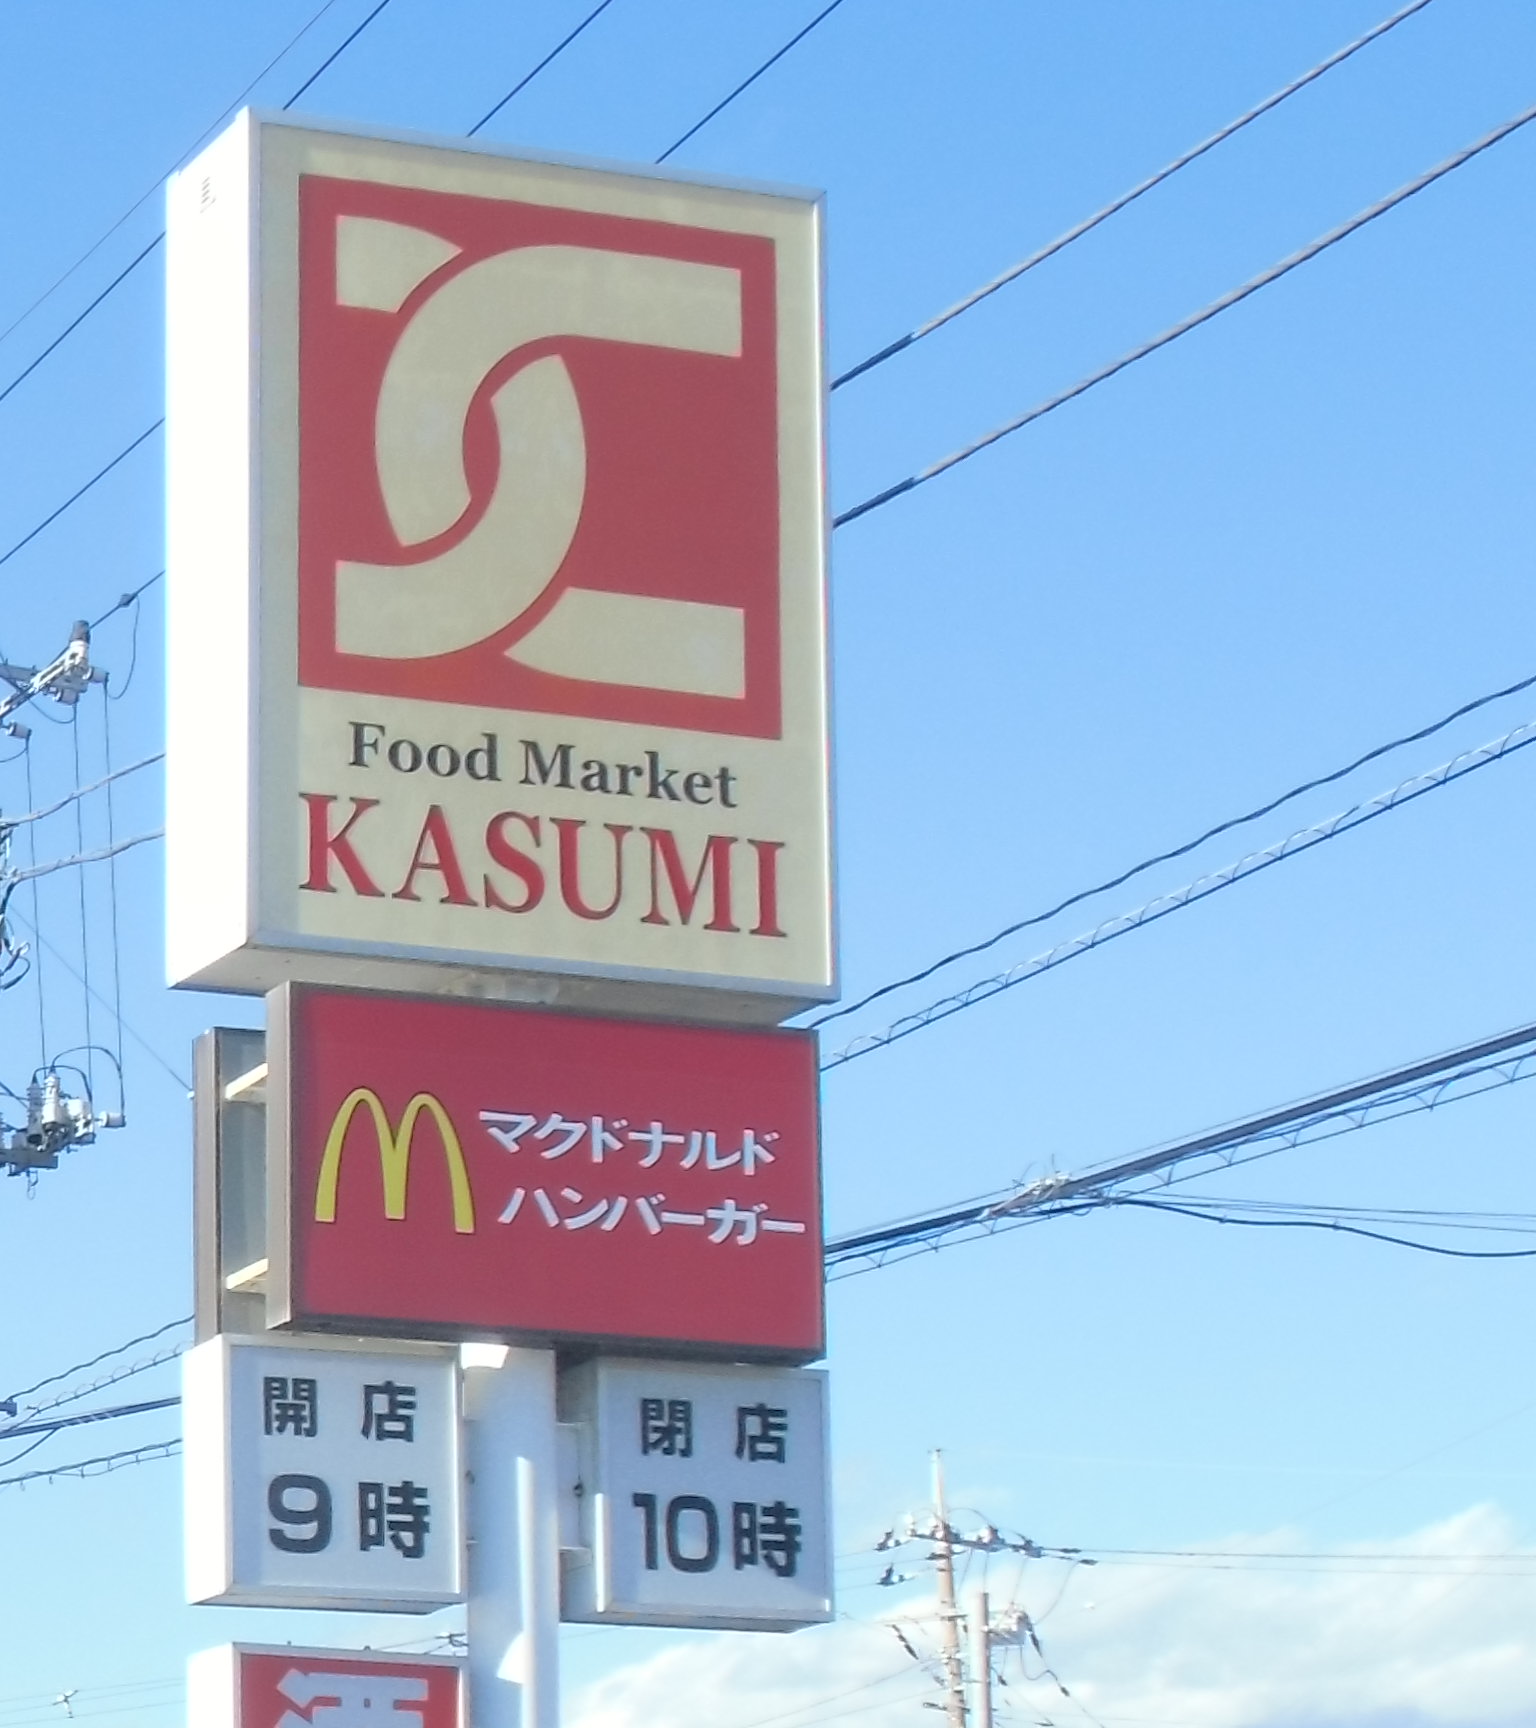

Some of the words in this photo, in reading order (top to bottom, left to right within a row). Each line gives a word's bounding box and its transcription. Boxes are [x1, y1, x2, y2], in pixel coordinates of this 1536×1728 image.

[349, 721, 502, 782] Food
[519, 740, 738, 809] Market
[298, 793, 788, 938] KASUMI
[479, 1108, 780, 1176] マクドナルド
[497, 1186, 805, 1246] ハンバーガー
[263, 1376, 417, 1443] 開店
[640, 1398, 789, 1464] 閉店
[267, 1473, 431, 1559] 9時
[632, 1492, 803, 1577] 10時
